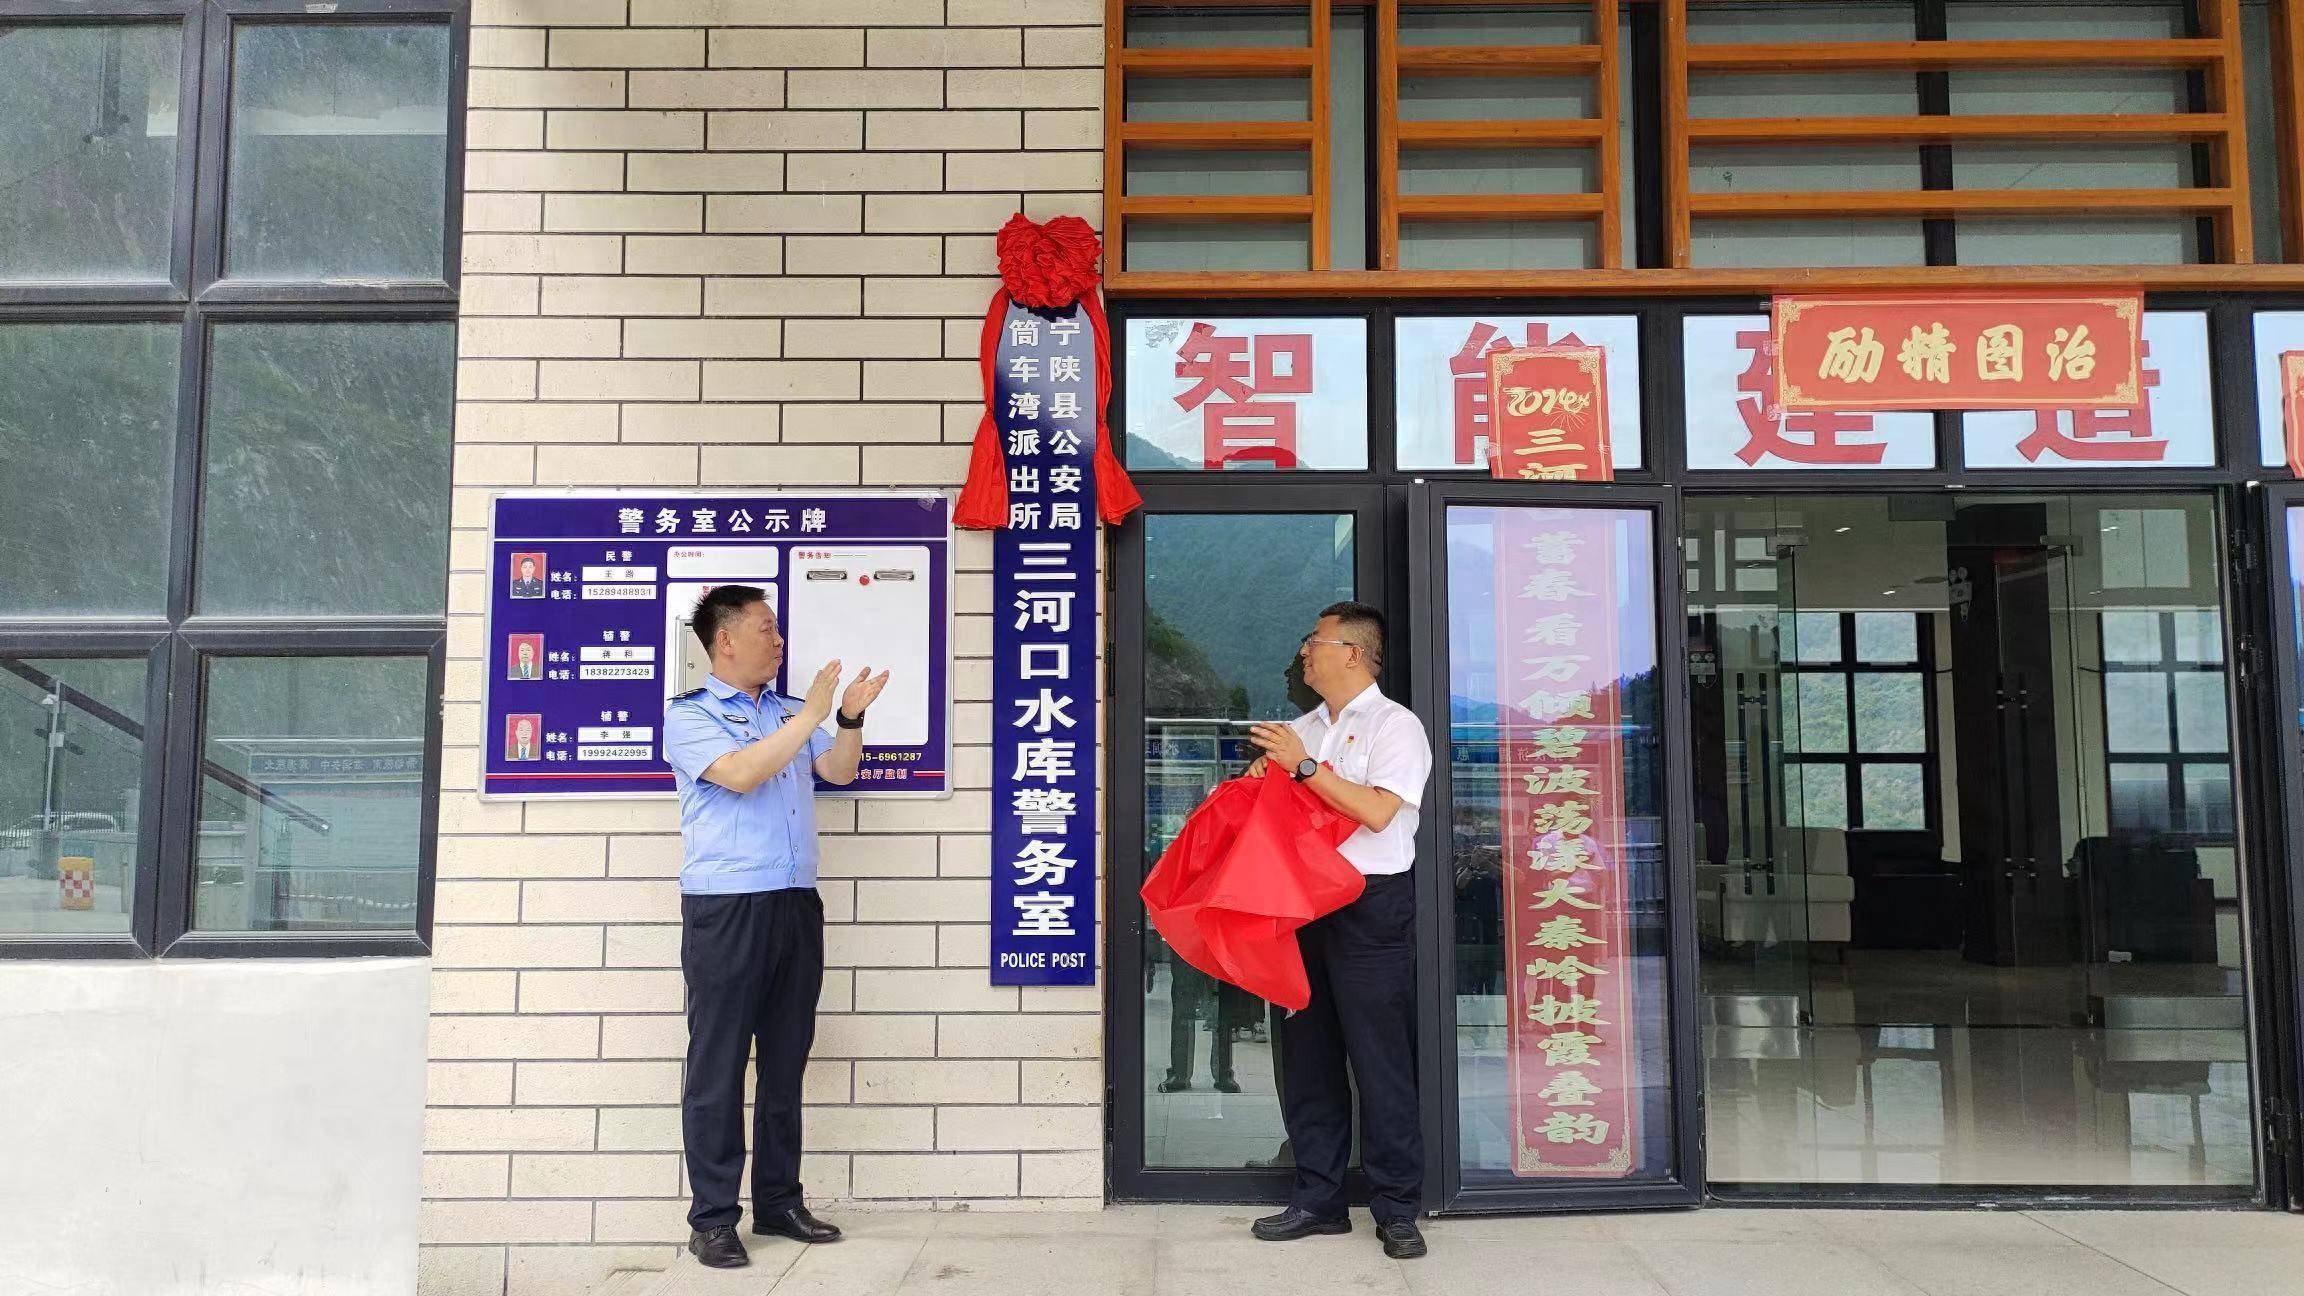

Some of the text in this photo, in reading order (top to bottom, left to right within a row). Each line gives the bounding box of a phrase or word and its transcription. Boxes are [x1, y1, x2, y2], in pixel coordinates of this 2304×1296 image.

[1818, 323, 2097, 384] 励精图治
[1007, 319, 1042, 530] 筒车湾派出所
[1048, 319, 1082, 530] 宁陕县公安局
[618, 507, 827, 534] 警务室公示牌
[605, 550, 633, 562] 民警
[798, 551, 832, 560] 警务告知
[602, 630, 631, 642] 辅警
[600, 710, 629, 722] 辅警
[1011, 542, 1078, 937] 三河口水库警务室
[582, 748, 648, 758] 19992422995
[1000, 952, 1087, 968] POLICE POST
